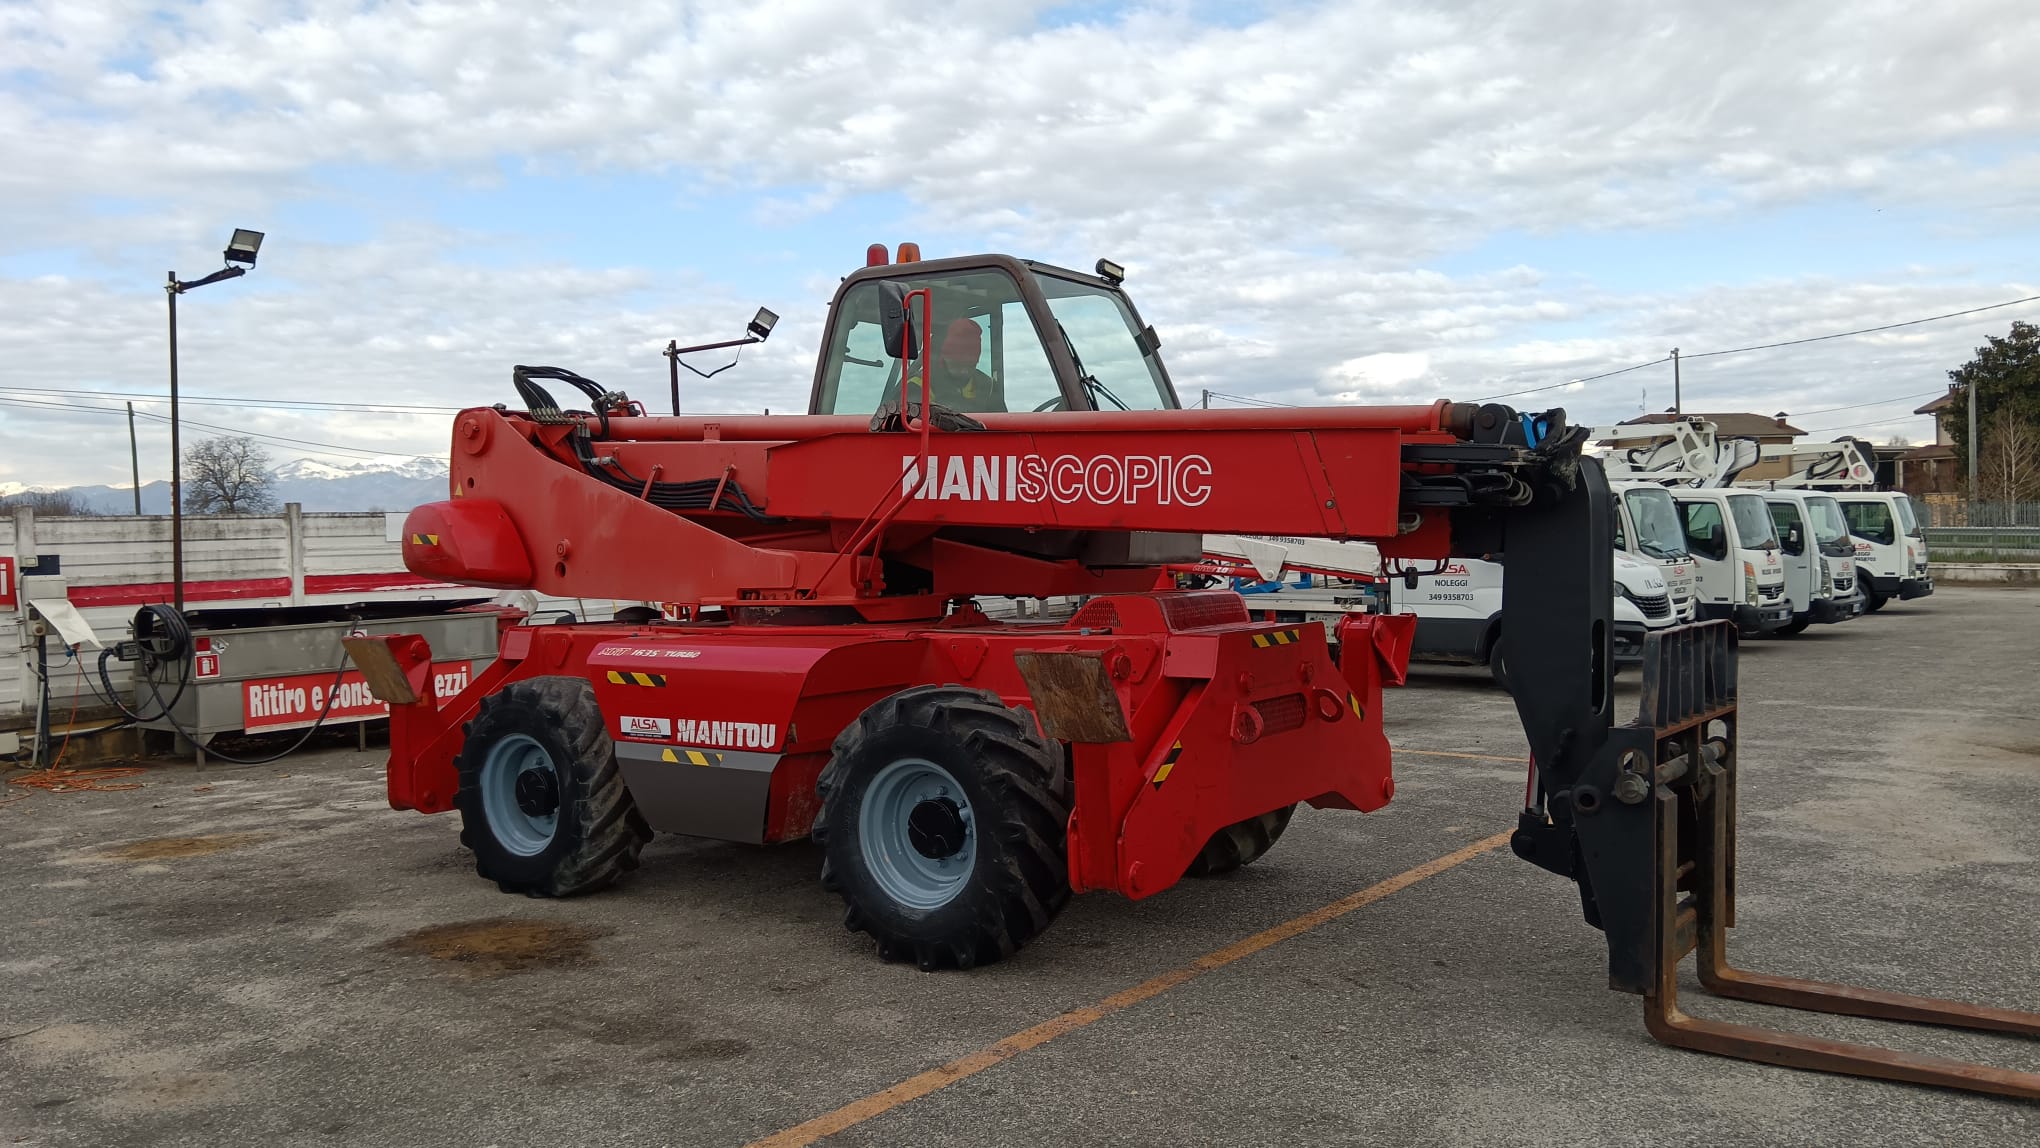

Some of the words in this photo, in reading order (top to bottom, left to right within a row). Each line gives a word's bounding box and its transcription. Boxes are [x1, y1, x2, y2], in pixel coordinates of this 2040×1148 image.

[902, 454, 1212, 507] MANISCOPIC
[1434, 579, 1468, 587] NOLEGGI
[1428, 593, 1442, 601] 349
[1442, 593, 1474, 601] 9358703
[631, 649, 660, 658] 1635
[665, 650, 701, 659] TURBO
[250, 683, 306, 718] Ritiro
[311, 685, 323, 711] e
[434, 666, 469, 698] ezzi
[630, 718, 659, 730] ALSA
[677, 718, 776, 749] MANITOU
